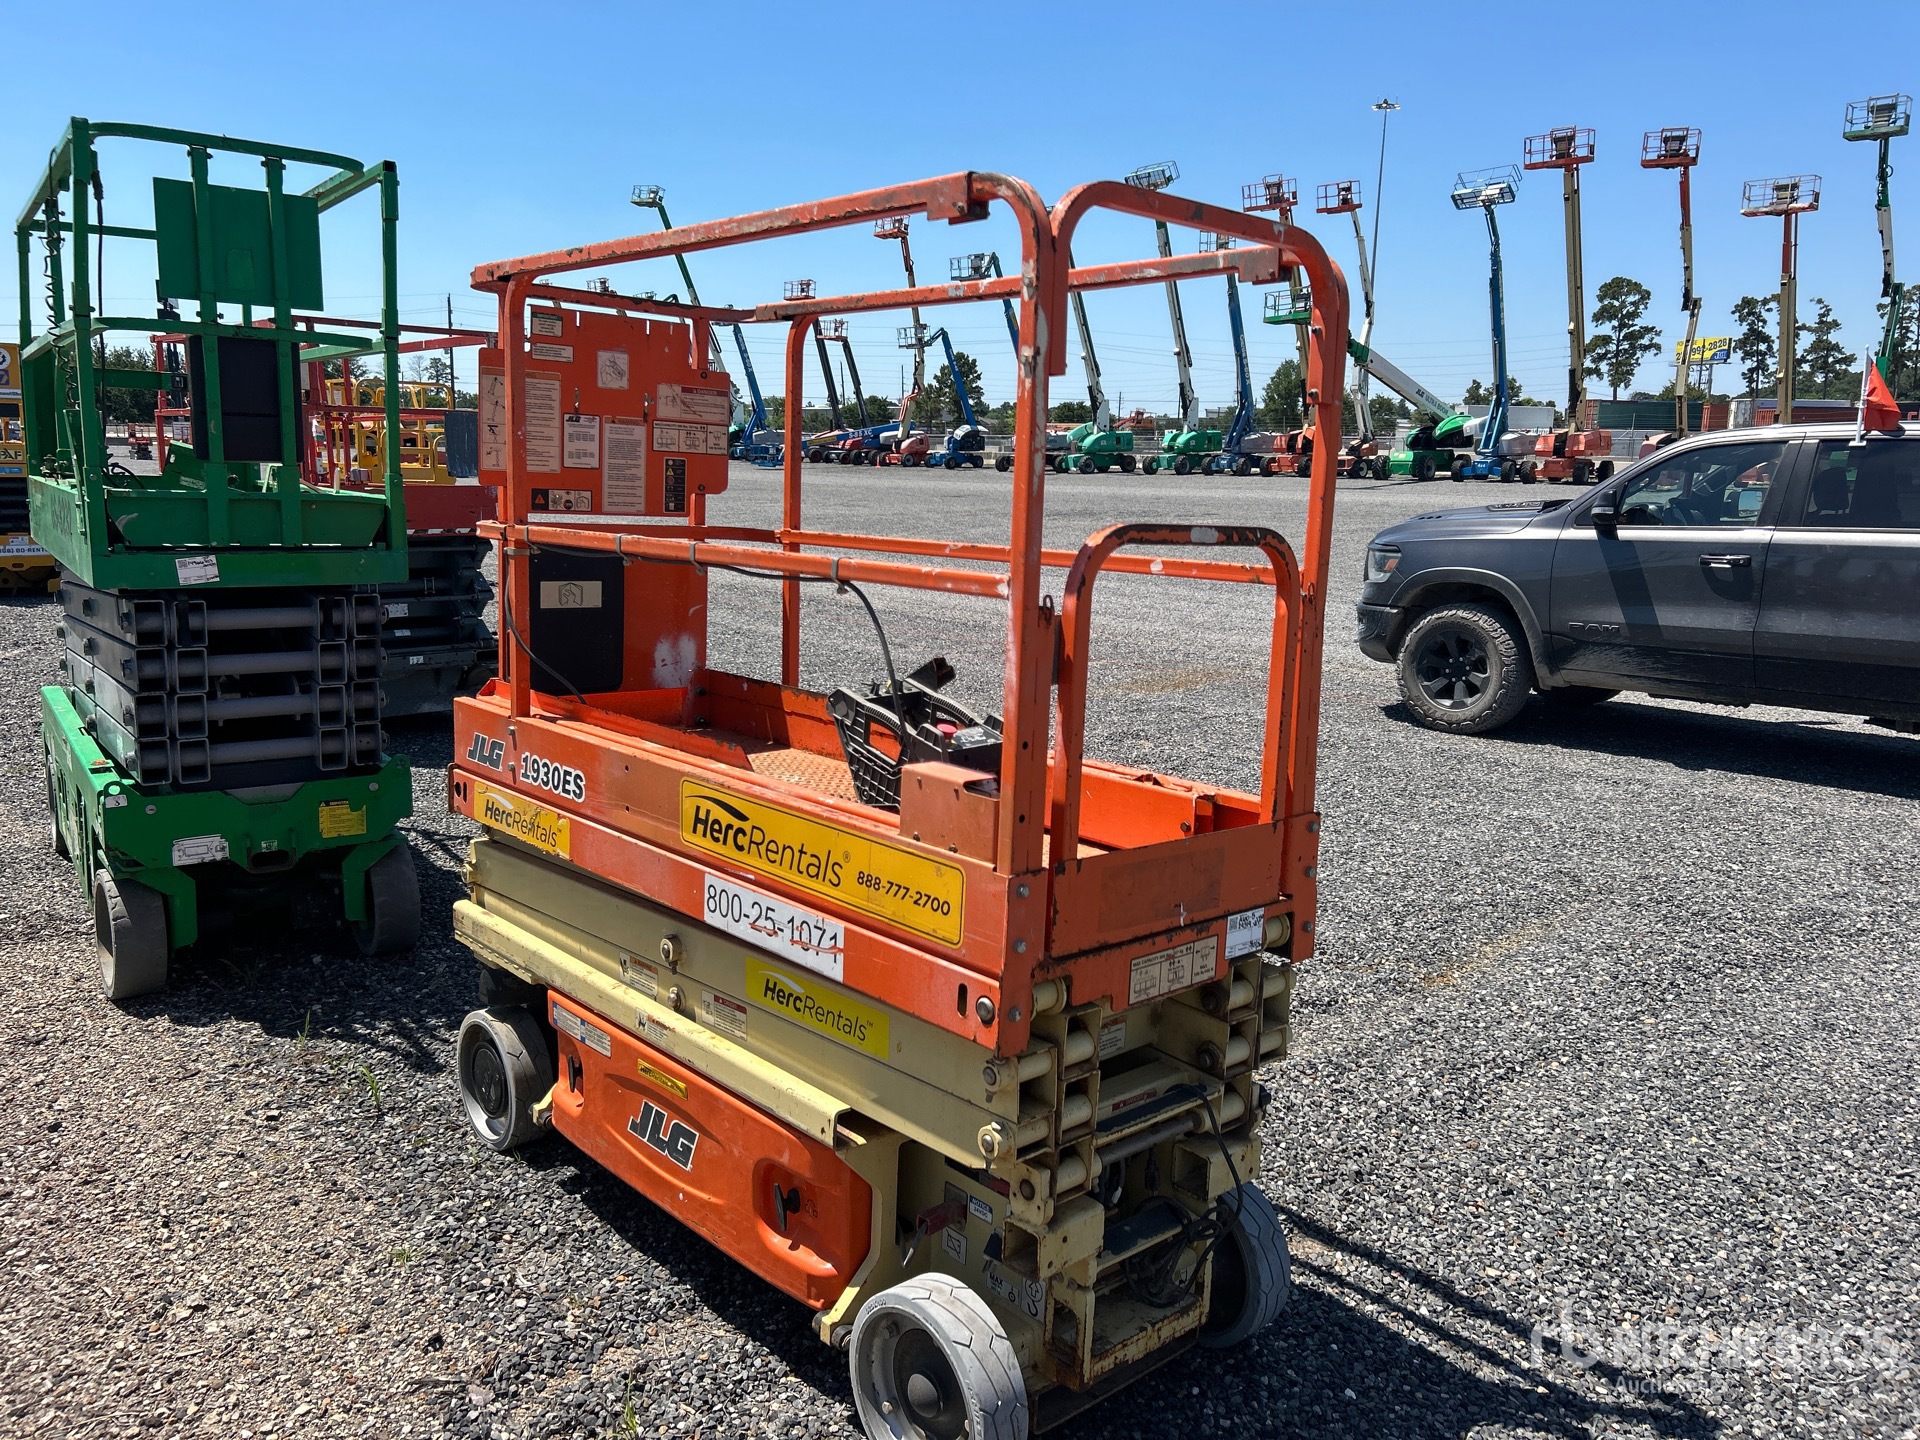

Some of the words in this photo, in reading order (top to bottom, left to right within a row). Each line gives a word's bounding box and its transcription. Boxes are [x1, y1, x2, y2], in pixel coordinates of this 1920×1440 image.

[1568, 621, 1620, 633] RAM
[467, 732, 505, 771] JLG
[520, 753, 586, 802] 1930ES
[485, 799, 559, 848] HercRentals
[692, 805, 844, 888] HercRentals
[857, 870, 951, 916] 888-777-2700
[706, 884, 839, 964] 800-25-1071
[763, 978, 867, 1042] HercRentals
[628, 1099, 699, 1171] JLG
[972, 1197, 991, 1211] NOTICE
[989, 1272, 1004, 1287] MAX
